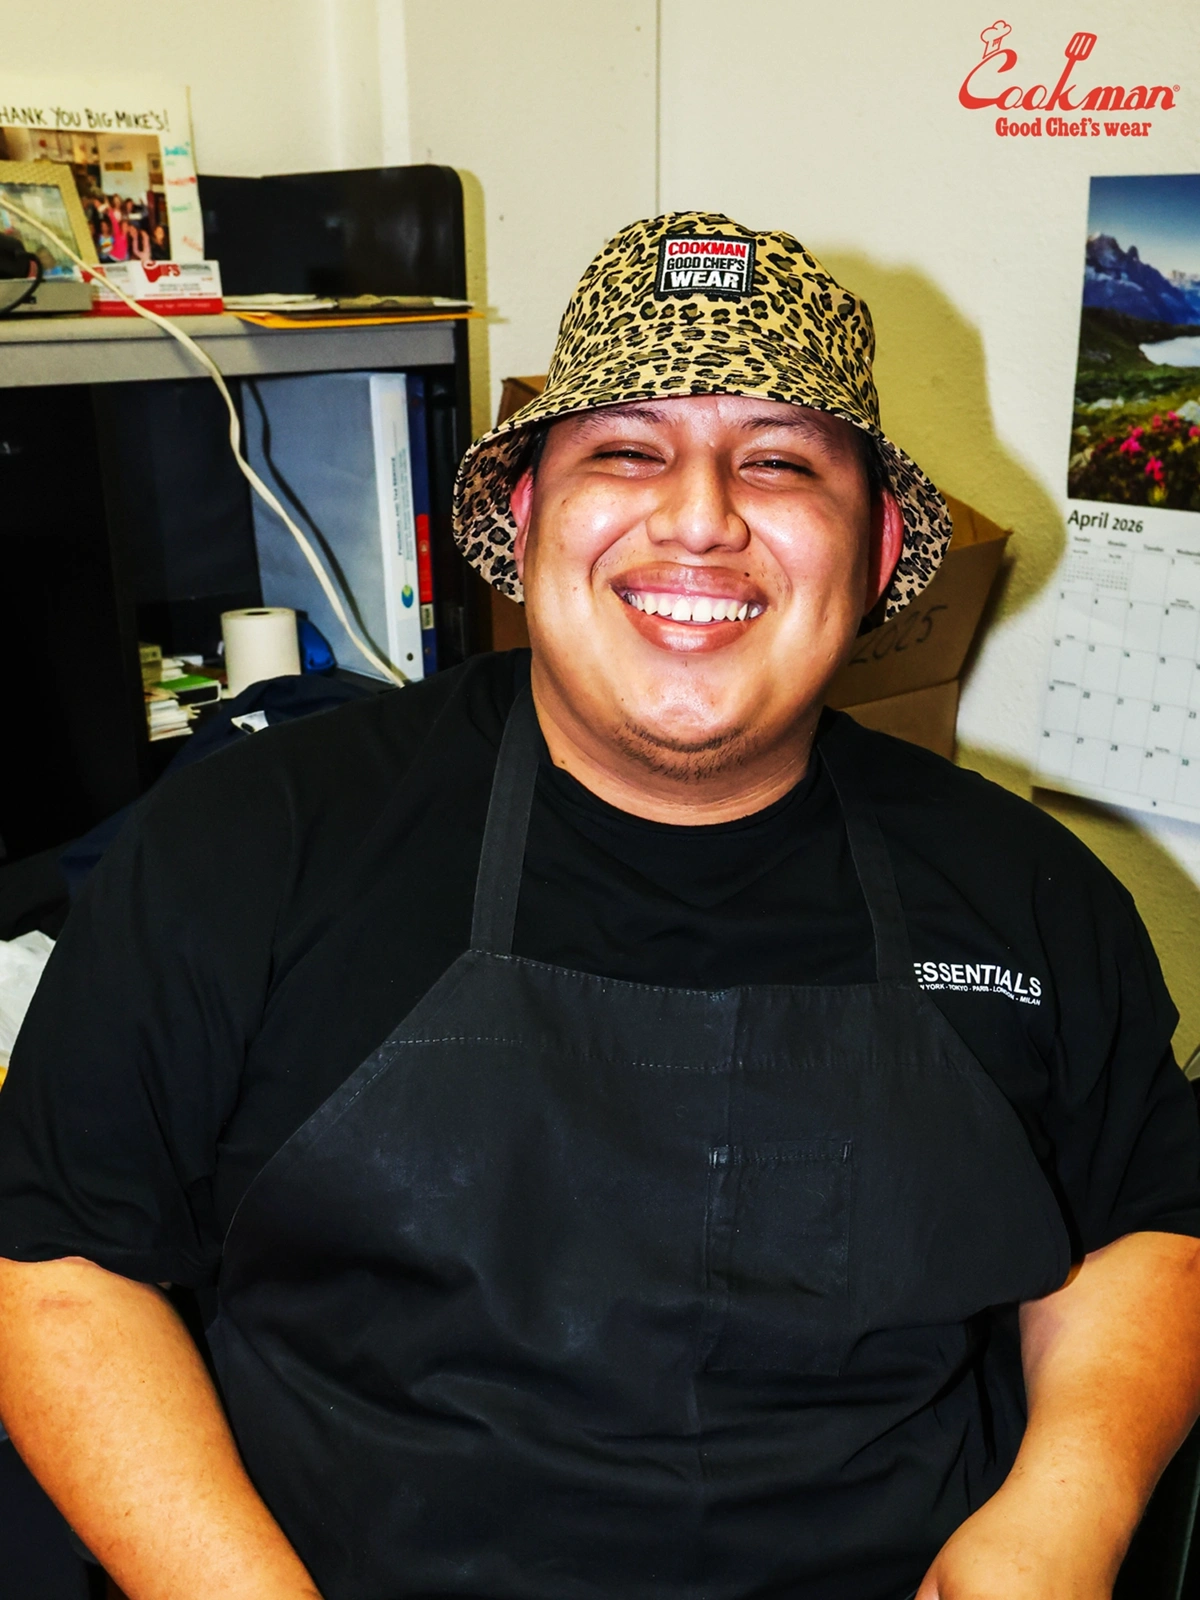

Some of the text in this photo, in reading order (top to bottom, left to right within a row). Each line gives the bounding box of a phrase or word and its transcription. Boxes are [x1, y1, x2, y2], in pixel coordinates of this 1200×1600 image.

[50, 107, 82, 128] YOU
[84, 108, 113, 128] BIG
[114, 108, 170, 132] MIKE'S!
[668, 241, 747, 258] COOKMAN
[666, 256, 745, 271] GOOD CHEF'S
[670, 271, 740, 288] WEAR
[1067, 509, 1144, 533] April 2026
[913, 961, 1042, 997] ESSENTIALS
[925, 983, 945, 991] YORK
[948, 983, 969, 992] TOKYO
[972, 985, 989, 993] PARIS
[1019, 996, 1041, 1006] MILAN
